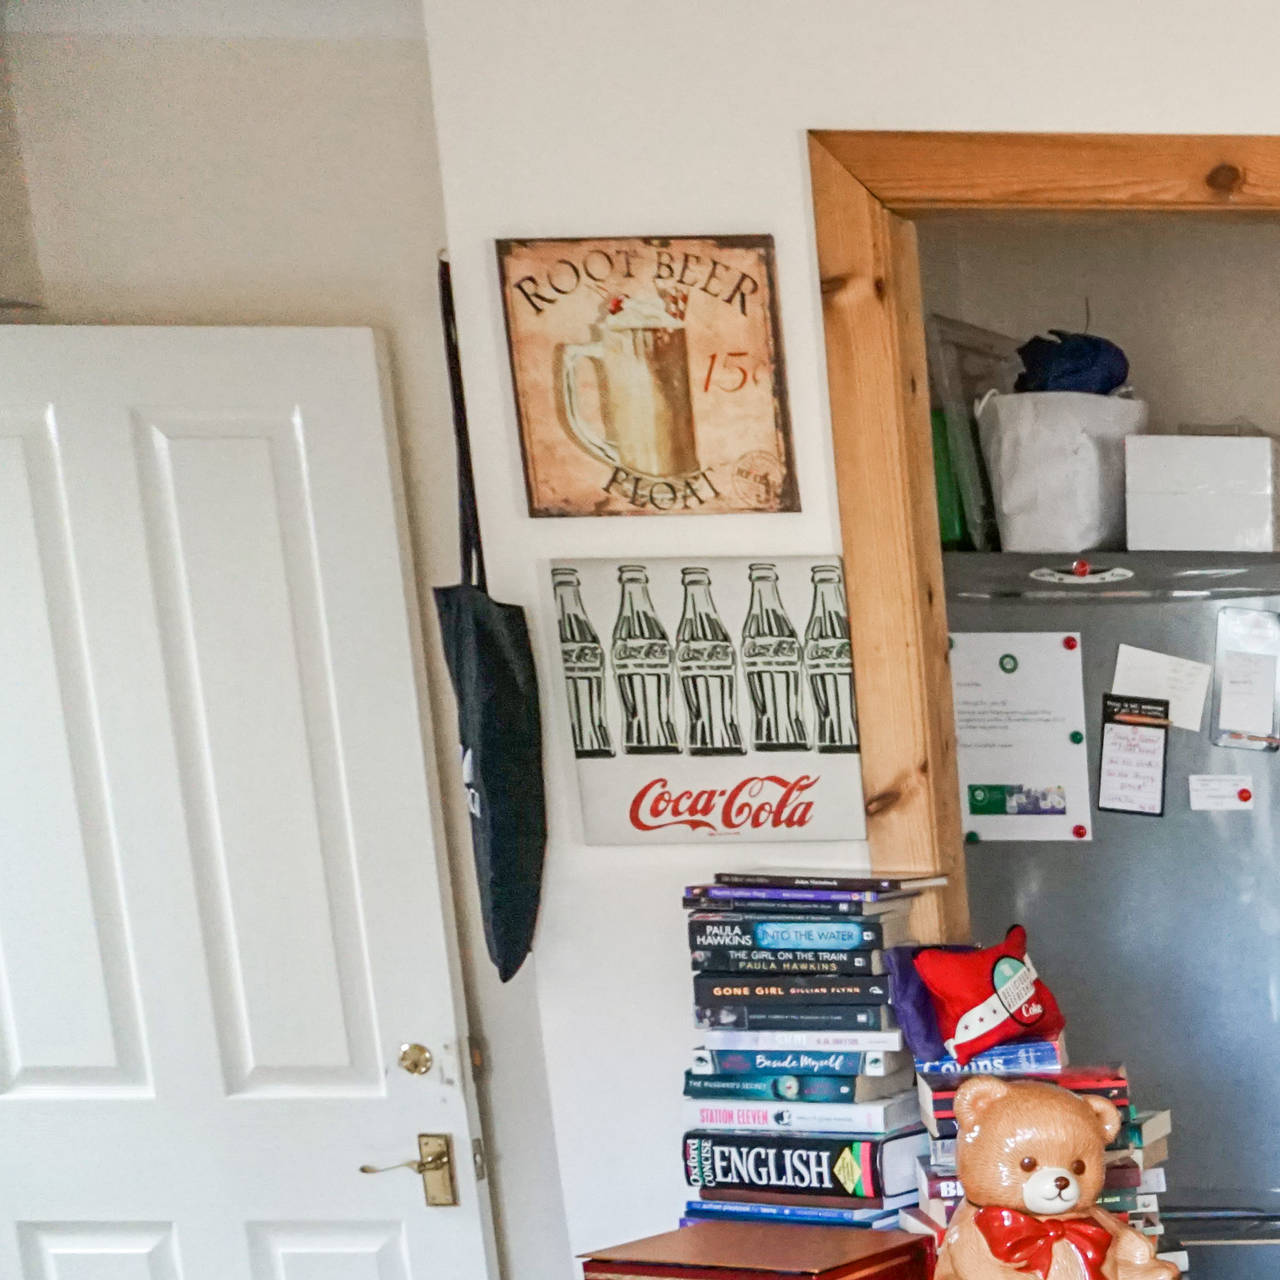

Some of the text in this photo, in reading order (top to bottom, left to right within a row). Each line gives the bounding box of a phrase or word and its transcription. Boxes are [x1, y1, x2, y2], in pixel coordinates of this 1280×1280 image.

[512, 248, 760, 318] ROOT BEER
[601, 464, 725, 512] FLOAT
[629, 775, 821, 832] Coca-Cola
[706, 925, 742, 936] PAULA
[760, 930, 854, 942] INTO THE WATER
[697, 935, 752, 946] HAWKINS
[729, 951, 848, 962] THE GIRL ON THE TRAIN
[739, 962, 838, 972] PAULA HAWKINS
[712, 986, 861, 996] GONE GIRL GILLIAN FLYNN
[1021, 1002, 1044, 1018] Coke
[755, 1054, 799, 1068] Beside
[799, 1055, 845, 1072] Myself
[699, 1108, 769, 1126] STATION ELEVEN
[686, 1138, 701, 1187] Oxford
[701, 1139, 716, 1188] CONCISE
[712, 1145, 834, 1189] ENGLISH
